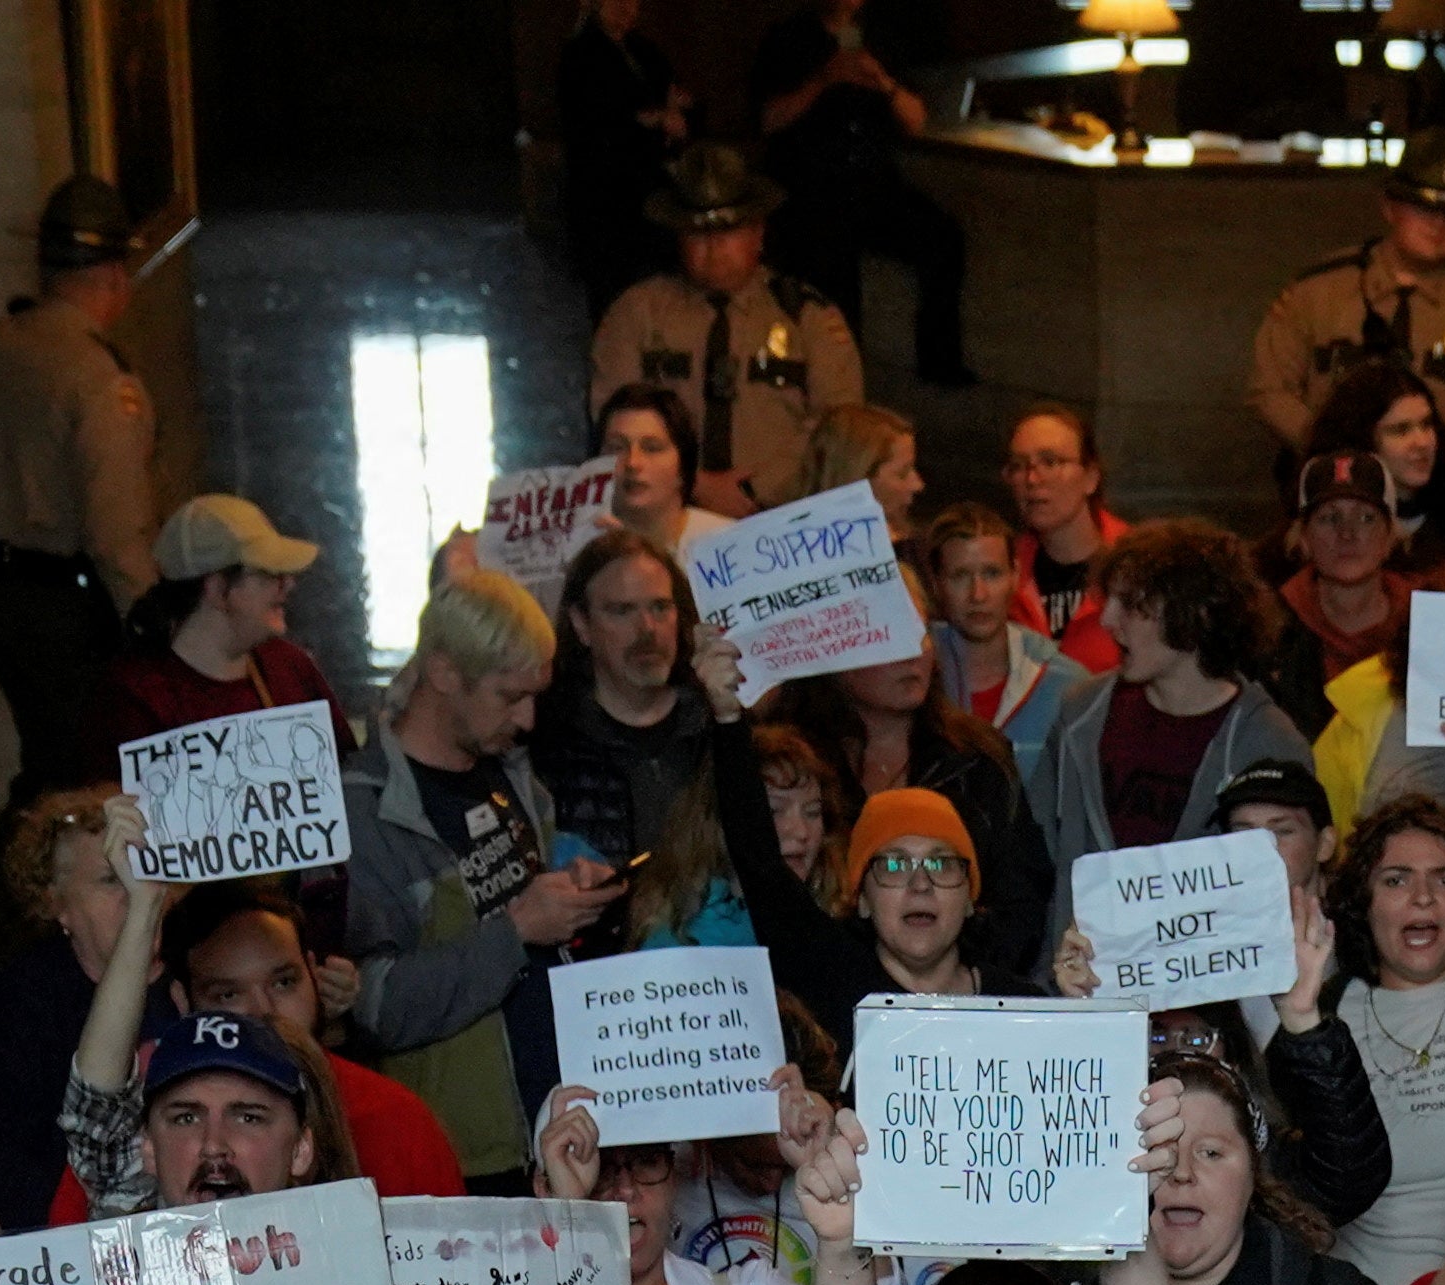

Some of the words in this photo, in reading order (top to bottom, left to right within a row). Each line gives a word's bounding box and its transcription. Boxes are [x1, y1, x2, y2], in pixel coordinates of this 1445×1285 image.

[695, 544, 745, 590] WE
[755, 515, 879, 575] SUPPORT
[739, 576, 842, 623] TENNESSEE
[843, 559, 898, 596] THREE
[124, 727, 231, 783] THEY
[242, 777, 323, 825] ARE
[138, 819, 341, 880] DEMOCRACY
[1117, 874, 1164, 904] WE
[1171, 862, 1244, 896] WILL
[1155, 910, 1216, 942] NOT
[1117, 961, 1155, 989] BE
[1165, 945, 1264, 984] SILENT
[584, 987, 636, 1010] Free
[643, 976, 726, 1004] Speech
[731, 976, 749, 996] is
[193, 1015, 240, 1050] KC
[597, 1024, 611, 1040] a
[618, 1015, 674, 1040] right
[680, 1011, 711, 1032] for
[592, 1047, 702, 1074] including
[709, 1041, 762, 1062] state
[976, 1058, 1009, 1093] ME
[1027, 1058, 1103, 1095] WHICH
[886, 1092, 937, 1129] GUN
[954, 1094, 1024, 1132] YOU'D
[1041, 1093, 1111, 1131] WANT
[879, 1128, 907, 1165] TO
[923, 1130, 950, 1167] BE
[967, 1132, 1025, 1168] SHOT
[1008, 1169, 1056, 1206] GOP
